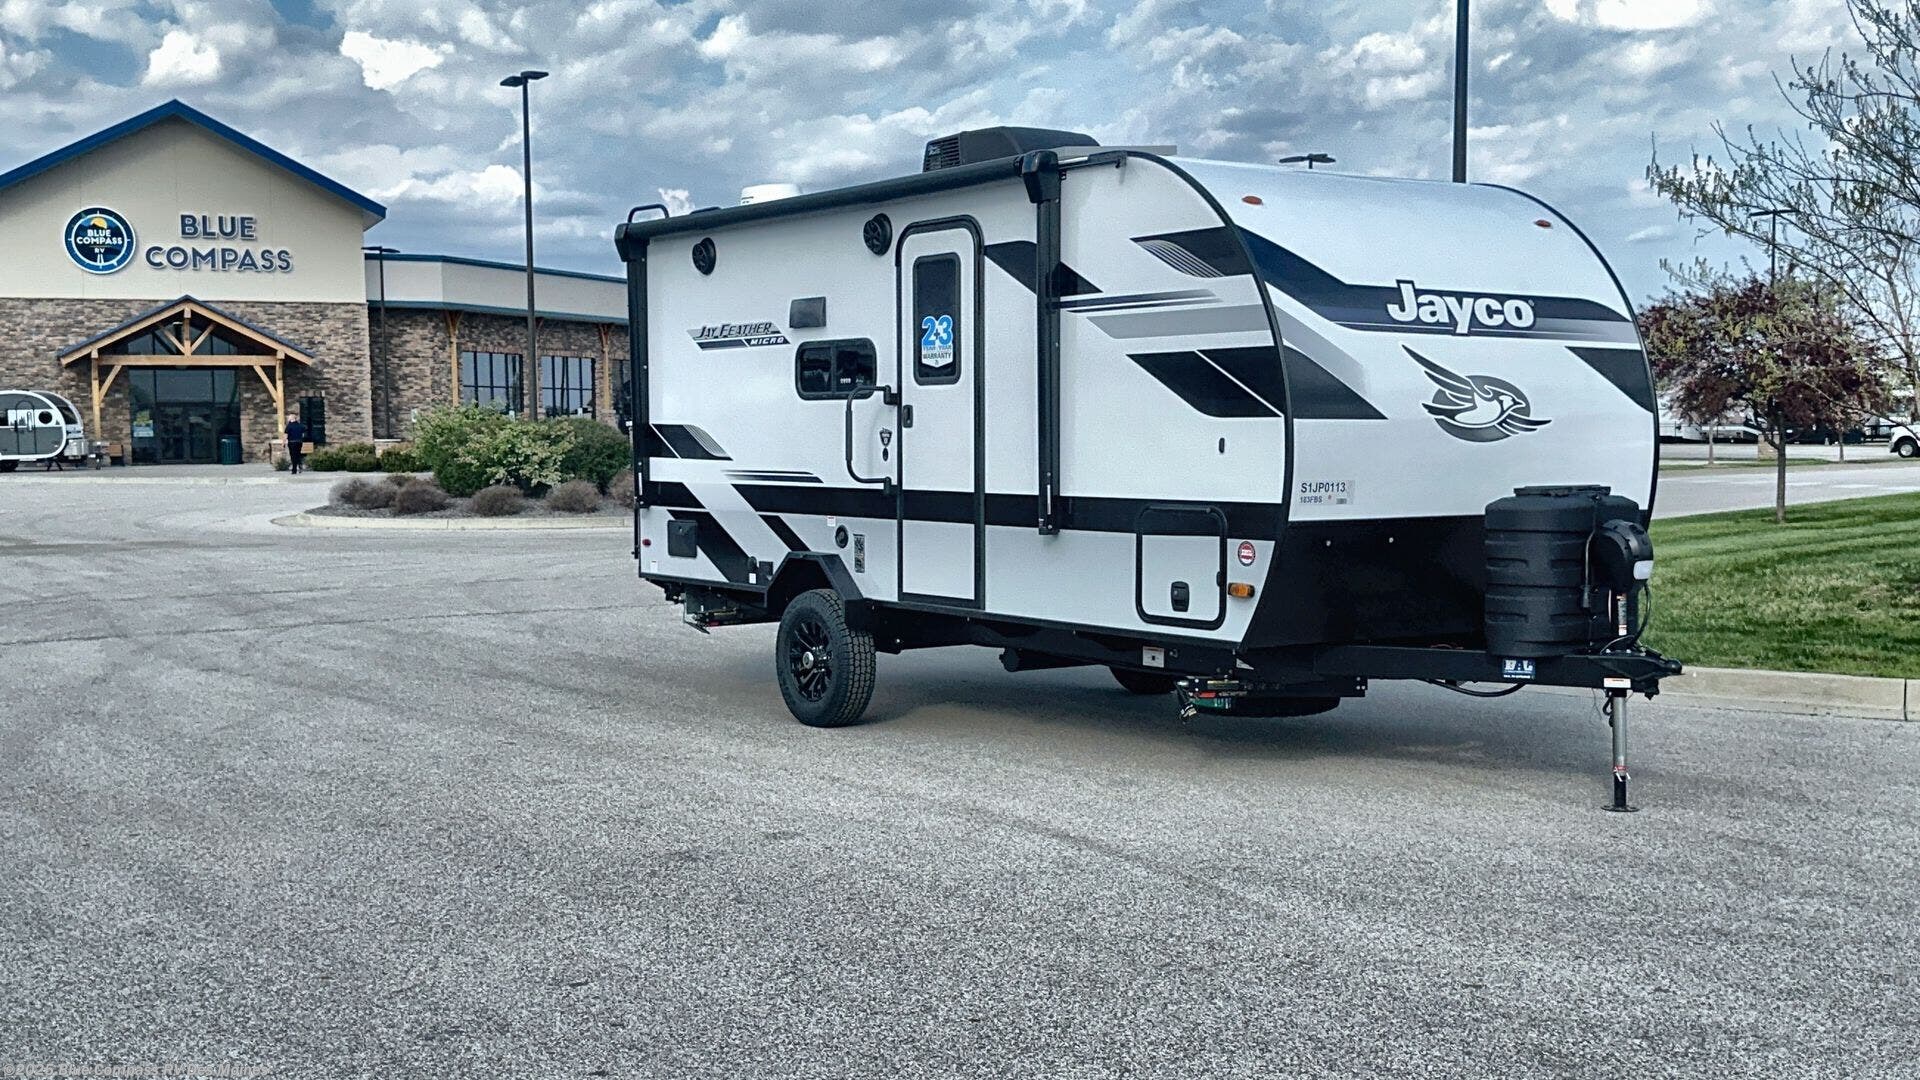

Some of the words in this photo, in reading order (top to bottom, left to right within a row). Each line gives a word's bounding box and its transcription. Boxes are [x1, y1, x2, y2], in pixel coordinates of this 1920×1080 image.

[87, 229, 111, 237] BLUE
[180, 214, 256, 239] BLUE
[76, 236, 123, 245] COMPASS
[145, 246, 292, 272] COMPASS
[1386, 280, 1535, 334] Jayco
[720, 321, 772, 338] FEATHER
[749, 336, 784, 346] MICRO
[1300, 482, 1346, 493] S1JP0113
